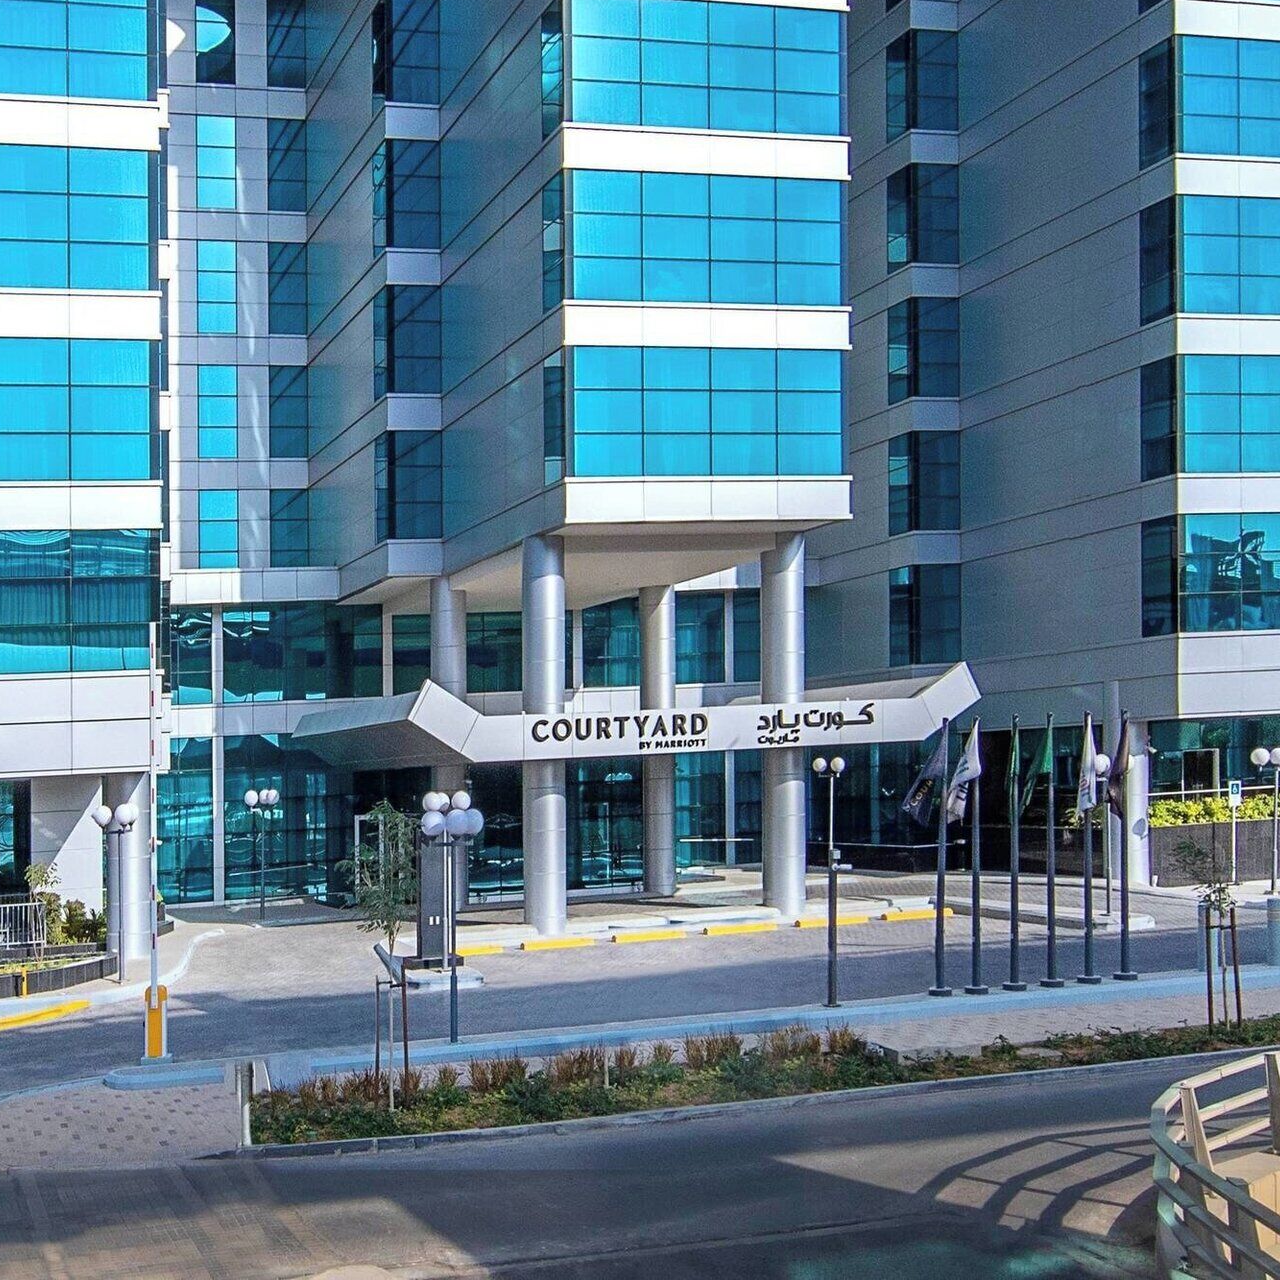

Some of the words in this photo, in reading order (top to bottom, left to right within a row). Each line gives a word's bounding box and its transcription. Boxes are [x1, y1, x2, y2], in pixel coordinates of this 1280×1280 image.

[531, 713, 708, 742] COURTYARD
[757, 709, 800, 734] يارد
[803, 702, 874, 731] كورت
[639, 741, 652, 750] BY
[655, 739, 707, 749] MARRIOTT
[757, 733, 800, 745] ماريوت
